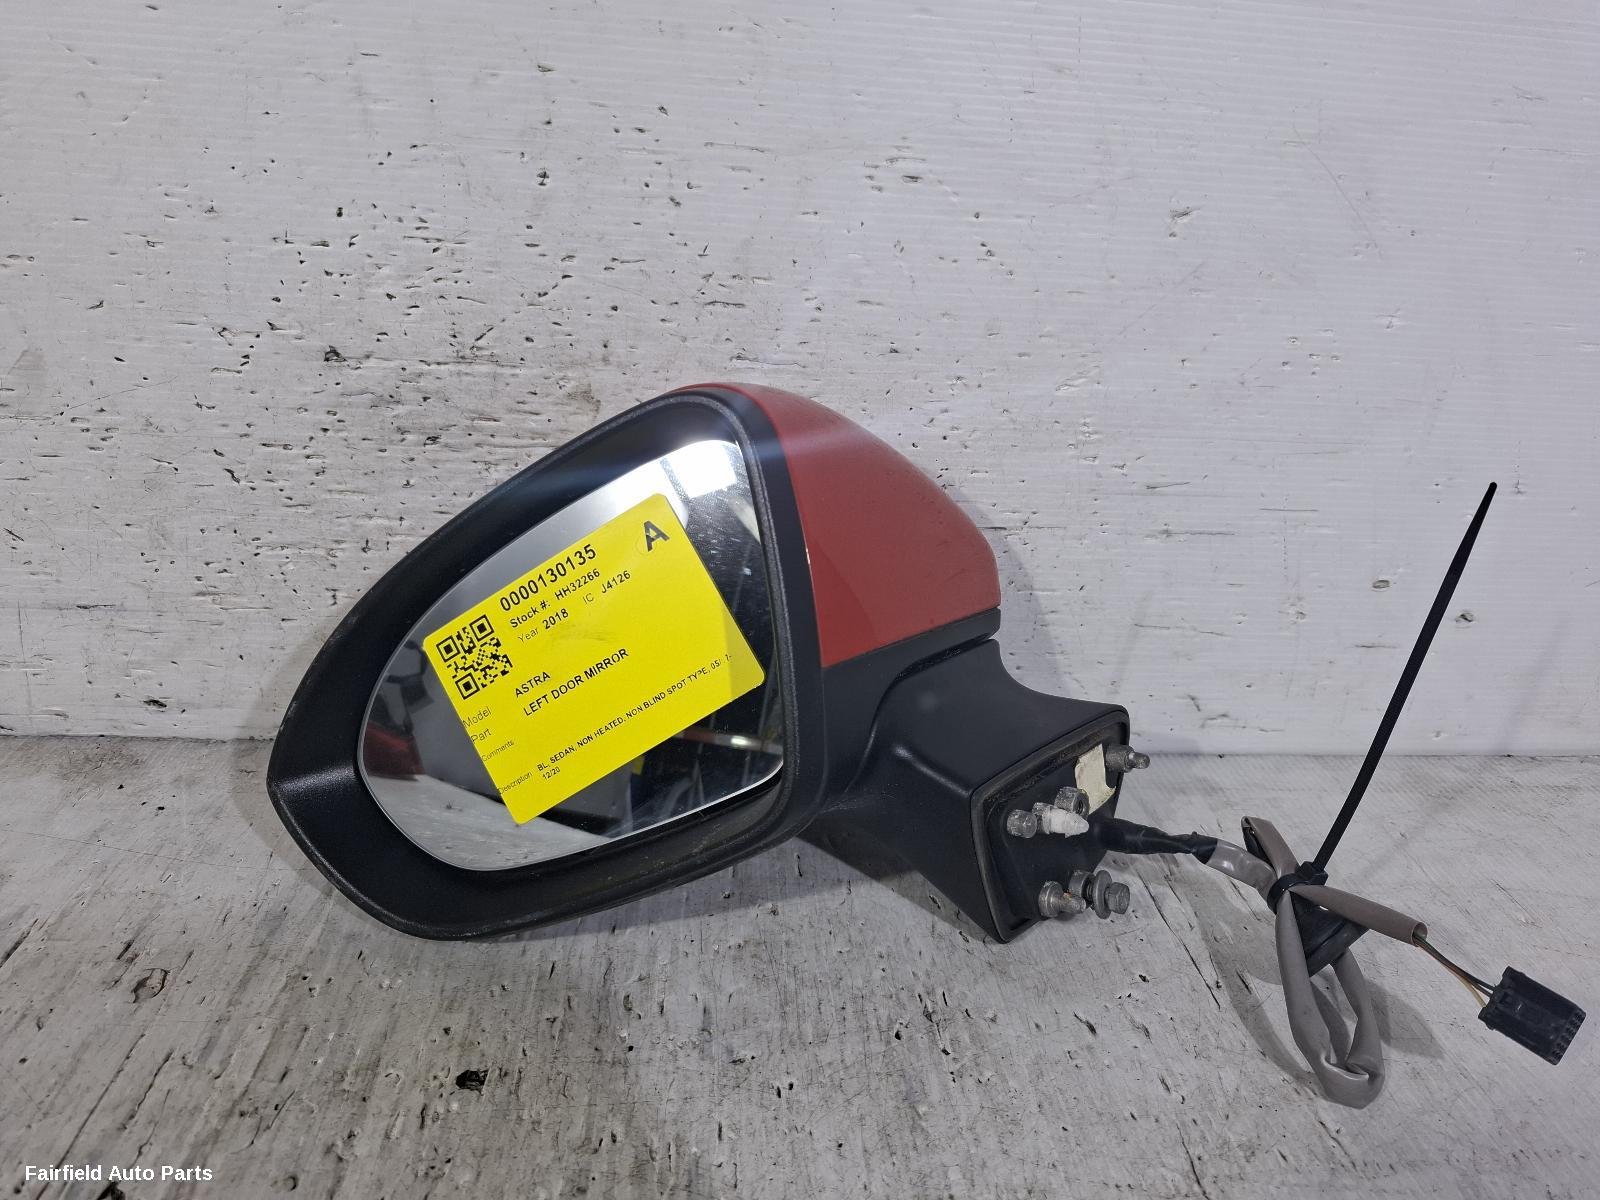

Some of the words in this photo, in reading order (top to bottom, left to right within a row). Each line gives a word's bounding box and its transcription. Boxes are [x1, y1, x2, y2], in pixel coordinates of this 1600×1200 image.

[644, 521, 670, 552] A
[500, 544, 596, 611] 0000130135
[510, 607, 539, 628] Stock
[555, 568, 600, 600] HH32266
[517, 626, 540, 643] Year
[542, 608, 568, 629] 2018
[583, 593, 594, 604] IC
[601, 570, 631, 594] J4126
[463, 706, 492, 727] Model
[514, 671, 551, 698] ASTRA
[471, 728, 492, 743] Part
[523, 694, 550, 716] LEFT
[551, 675, 584, 699] DOOR
[584, 649, 629, 679] MIRROR
[481, 740, 515, 762] Comments
[498, 771, 533, 795] Description
[550, 746, 577, 763] SEDAN,
[577, 735, 593, 747] NON
[626, 706, 643, 719] NON
[643, 692, 666, 709] BLIND
[667, 679, 686, 694] SPOT
[543, 767, 560, 780] 12/20
